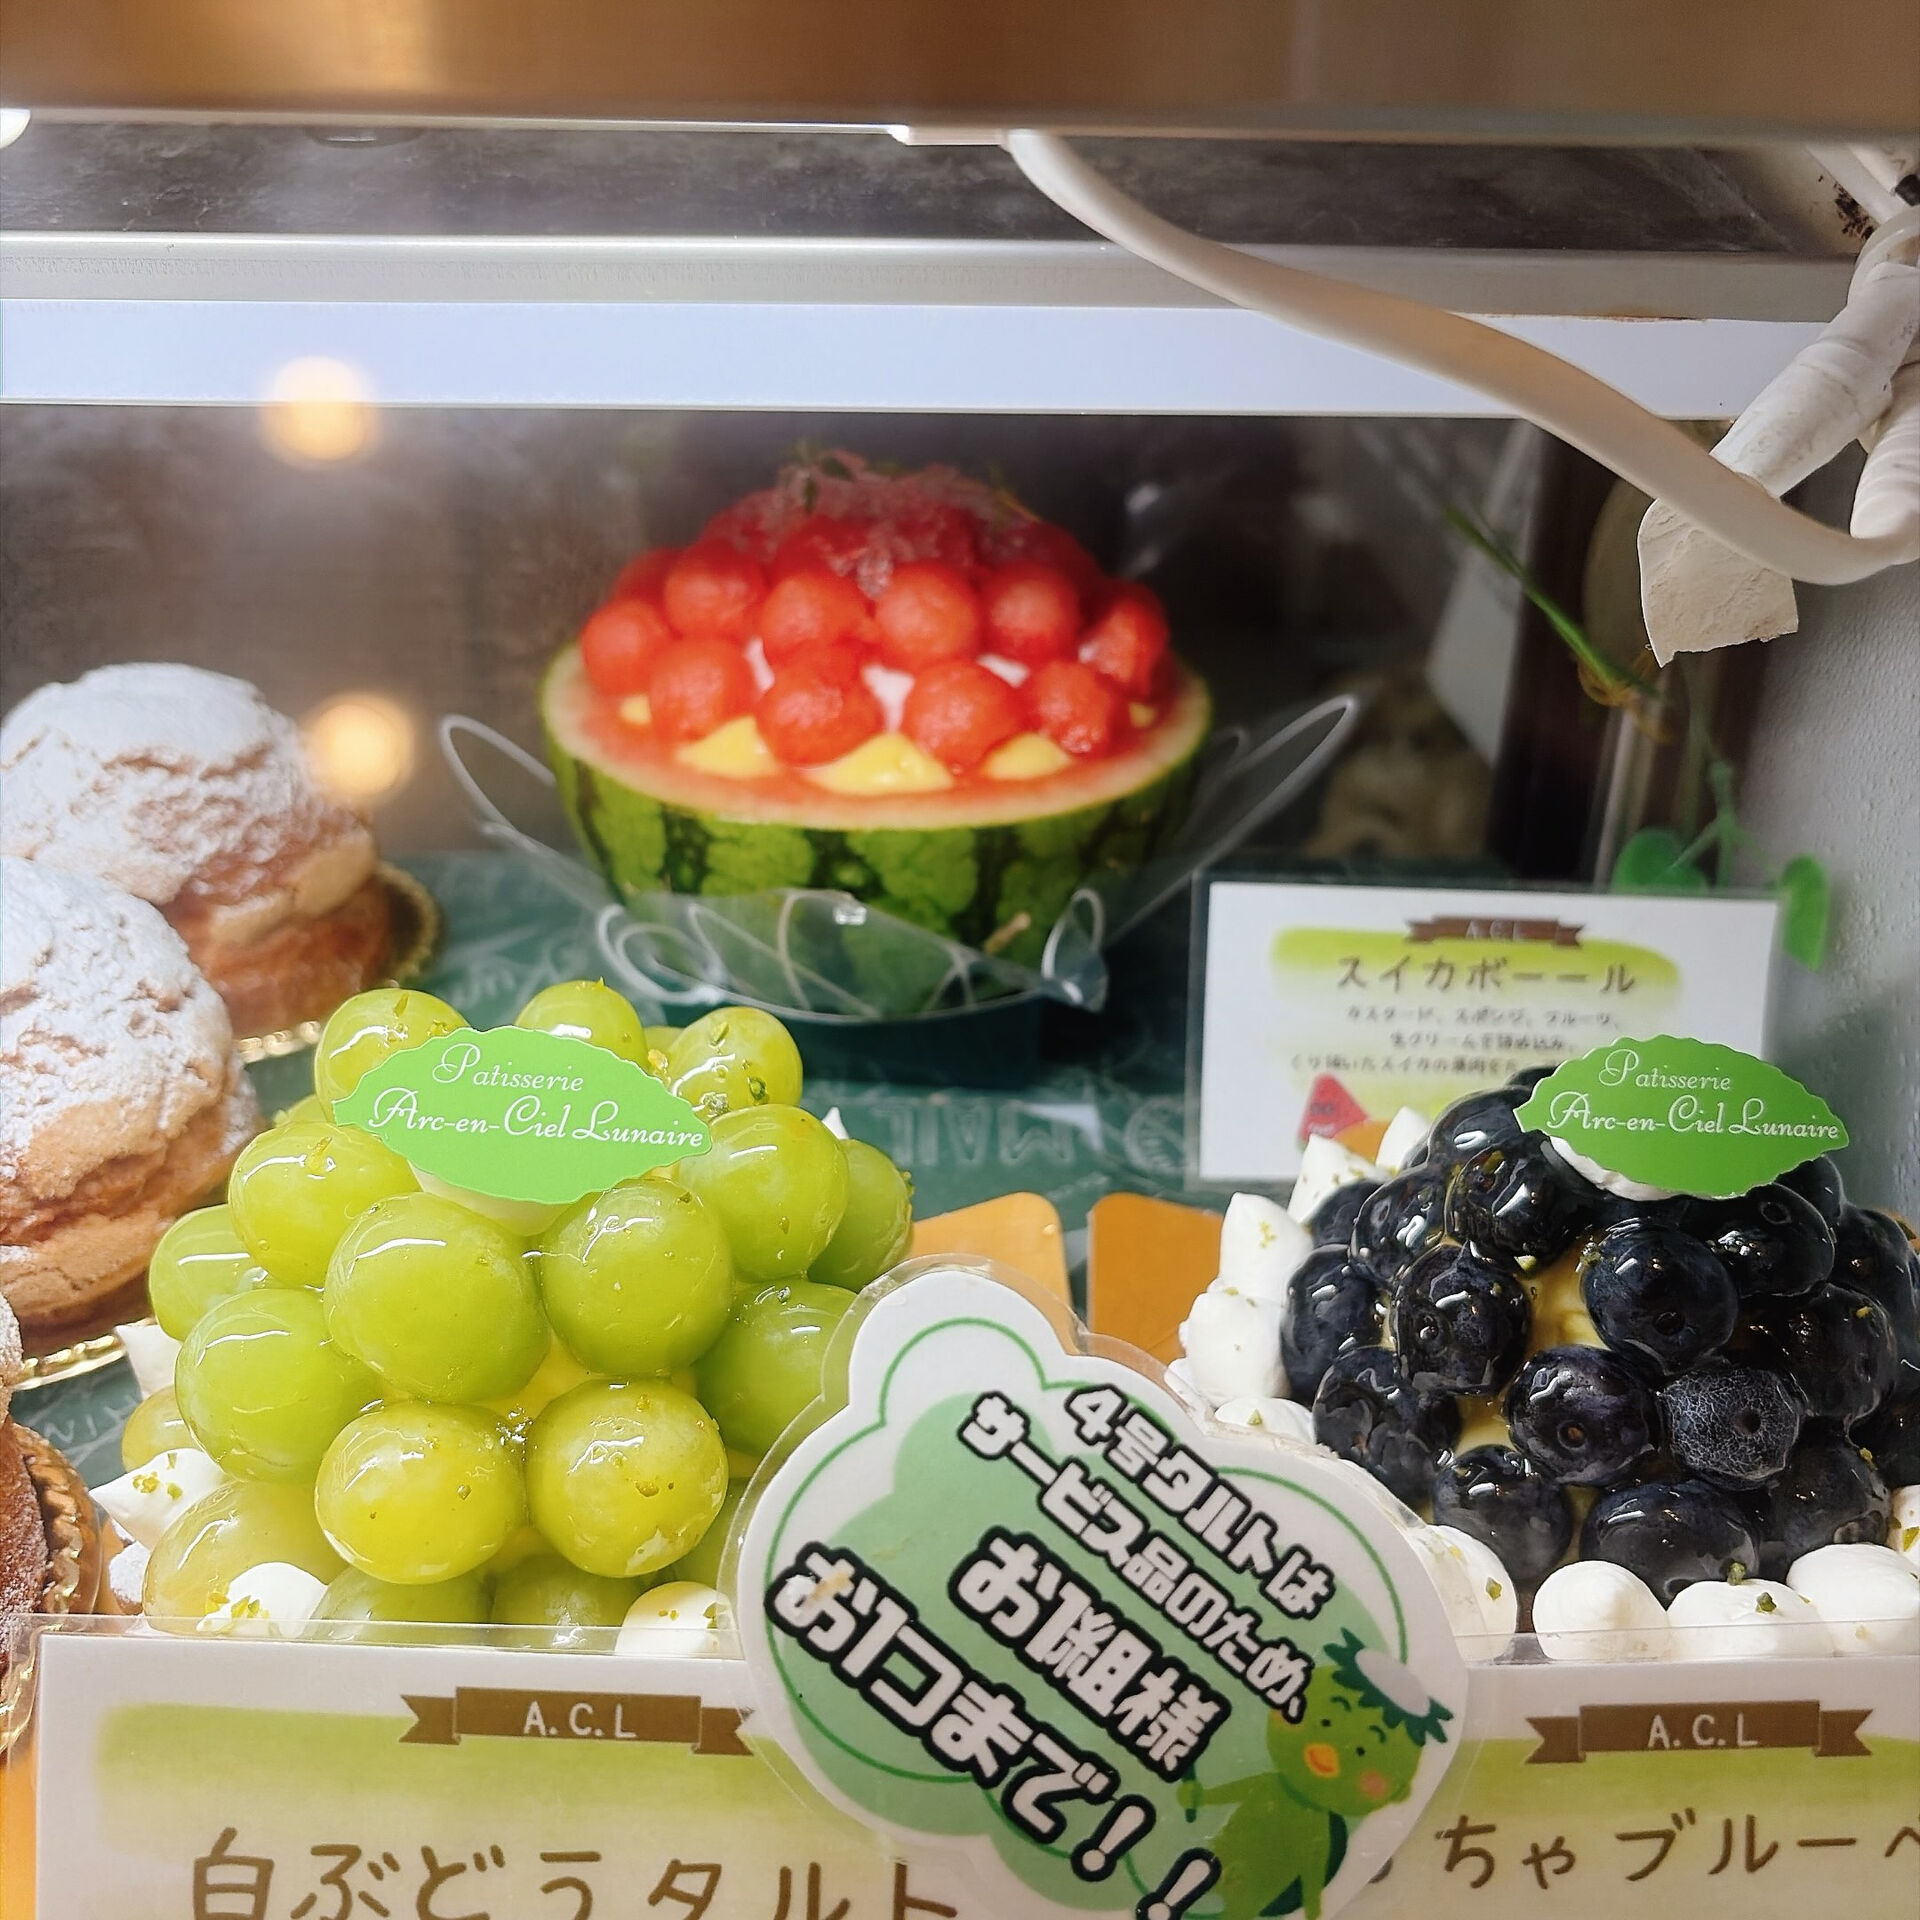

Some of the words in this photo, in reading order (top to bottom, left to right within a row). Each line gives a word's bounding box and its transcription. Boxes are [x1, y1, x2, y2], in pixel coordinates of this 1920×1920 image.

[432, 1041, 586, 1094] Patisserie
[1598, 1048, 1732, 1093] Patisserie
[367, 1085, 572, 1142] Arc-en-Ciel
[572, 1103, 706, 1150] Lunaire
[1545, 1090, 1726, 1134] Arc-en-Ciel
[1727, 1098, 1840, 1140] Lunaire
[1064, 1384, 1336, 1620] 4号タルトは
[956, 1390, 1316, 1724] サービス品のため、
[947, 1528, 1232, 1782] お1組様
[522, 1701, 637, 1739] A.C.L
[1647, 1713, 1758, 1748] A.C.L
[193, 1826, 958, 1920] 白ぶどうタルト
[1368, 1807, 1920, 1890] ちゃブルー
